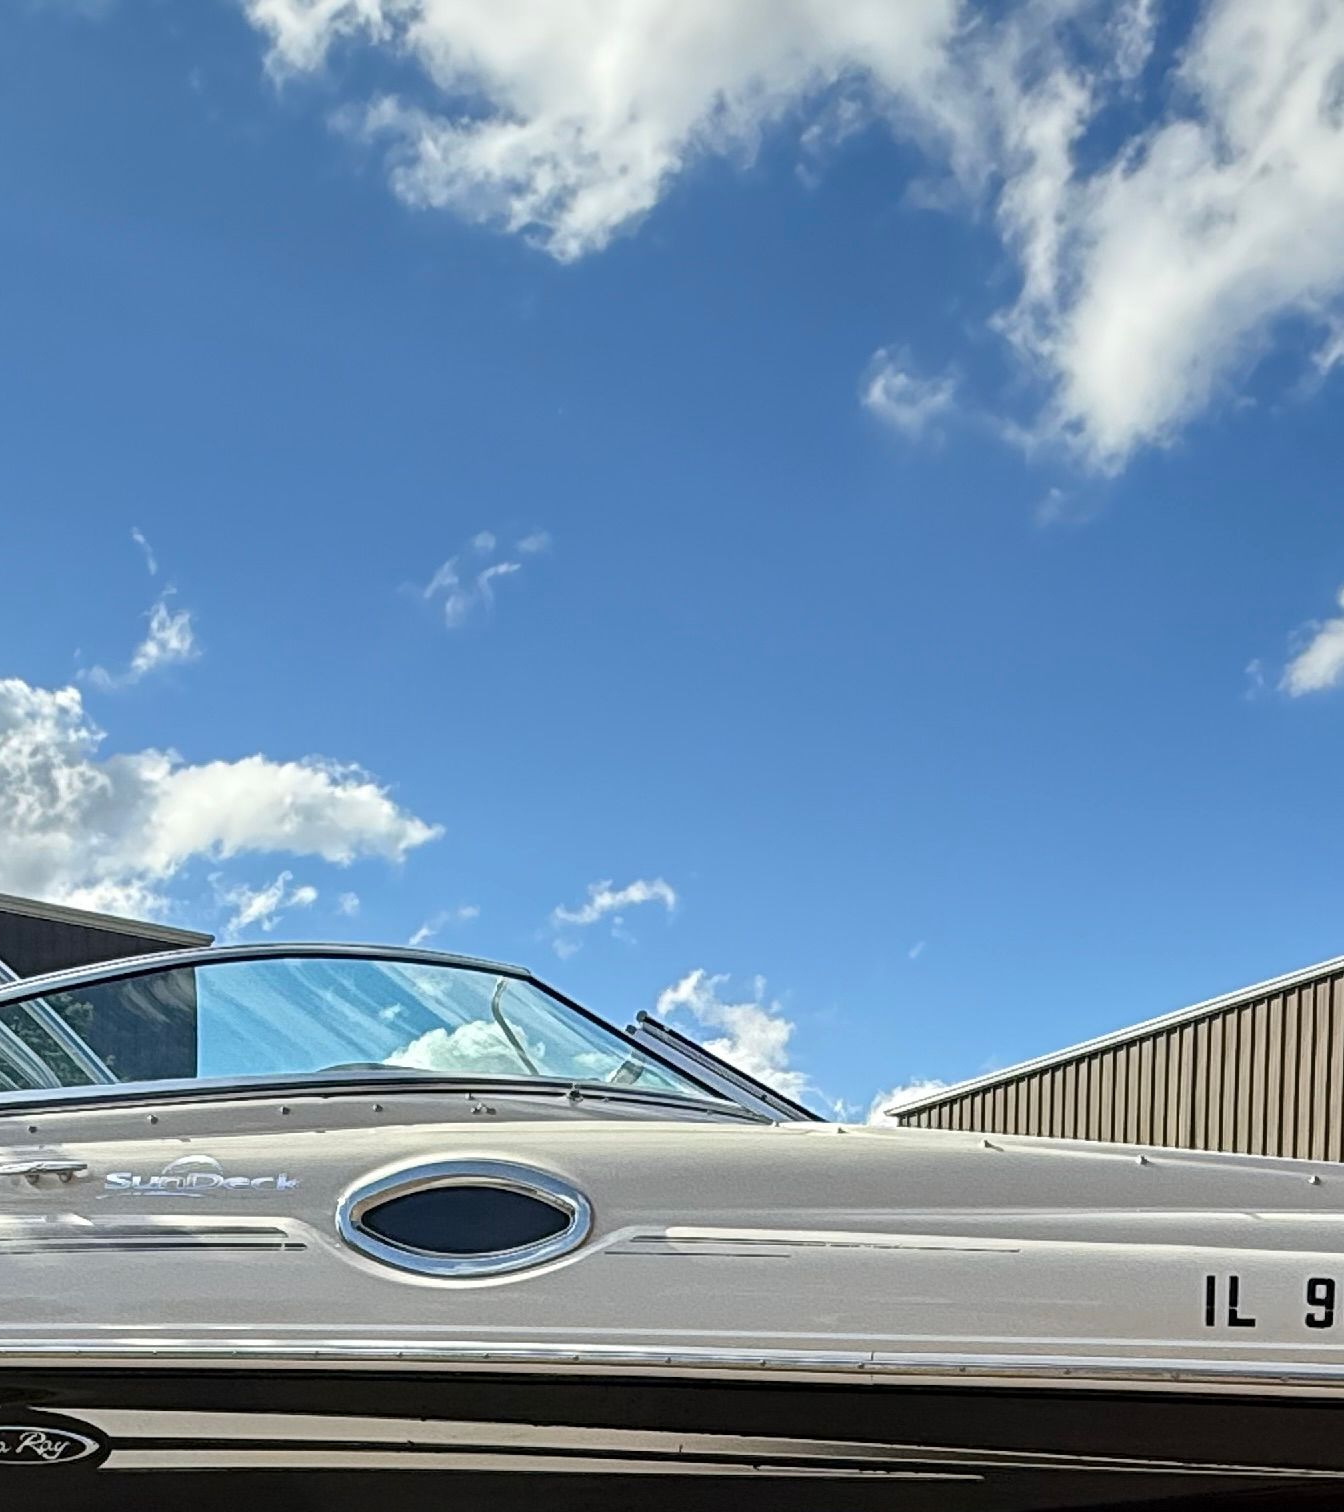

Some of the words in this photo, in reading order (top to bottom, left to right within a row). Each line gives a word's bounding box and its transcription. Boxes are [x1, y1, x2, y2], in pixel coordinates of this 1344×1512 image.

[104, 1171, 299, 1191] SunDeck
[1205, 1275, 1256, 1328] IL
[15, 1431, 70, 1460] Ray
